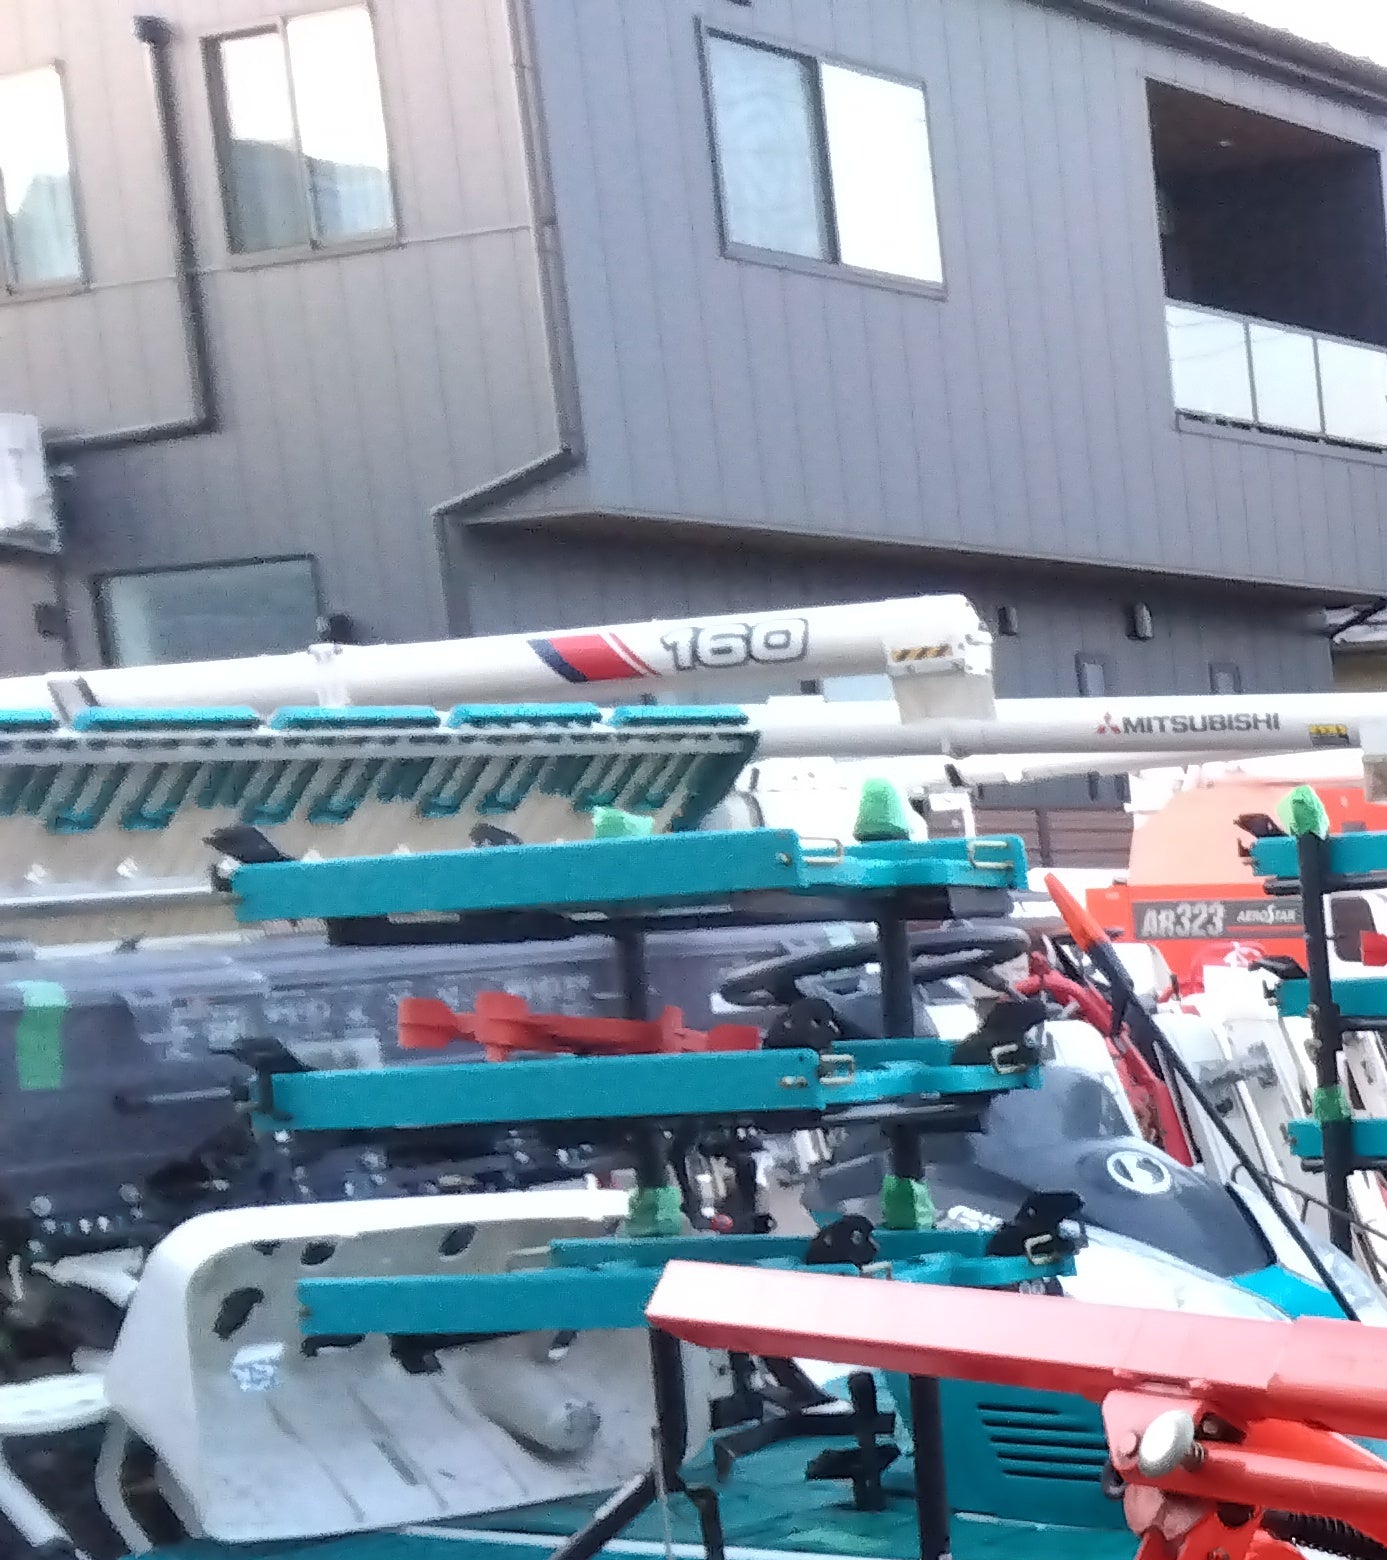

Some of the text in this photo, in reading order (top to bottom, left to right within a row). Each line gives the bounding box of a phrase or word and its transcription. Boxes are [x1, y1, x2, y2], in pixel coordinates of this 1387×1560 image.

[660, 618, 809, 671] 160
[1122, 713, 1280, 734] MITSUBISHI
[1141, 901, 1224, 937] AR323
